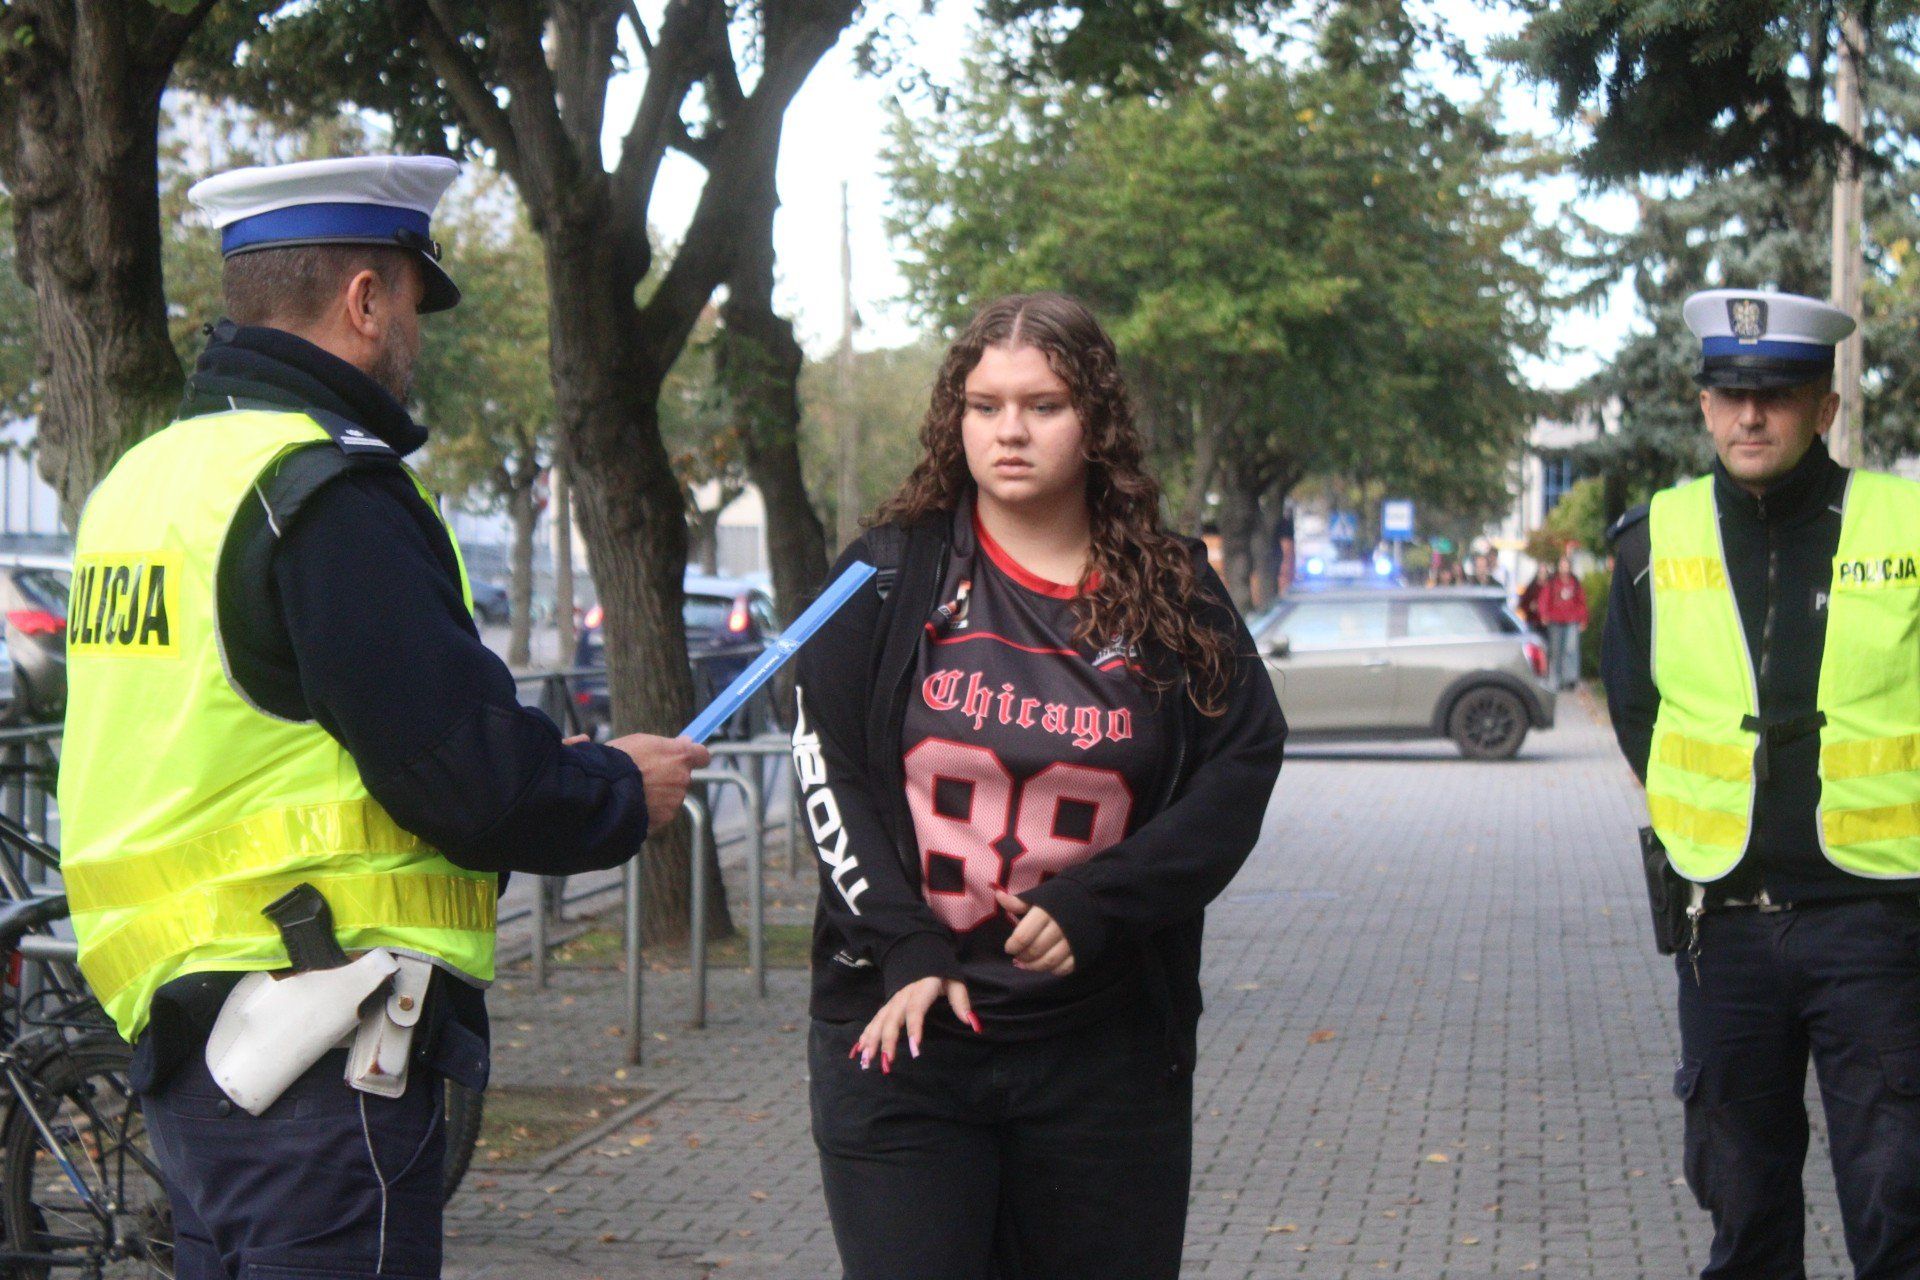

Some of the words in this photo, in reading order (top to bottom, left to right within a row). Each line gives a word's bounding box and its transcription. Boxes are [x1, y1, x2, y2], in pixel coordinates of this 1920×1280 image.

[70, 565, 169, 645] OLICJA
[1840, 558, 1917, 583] POLICJA
[922, 669, 1133, 750] Chicago
[903, 736, 1134, 932] 88
